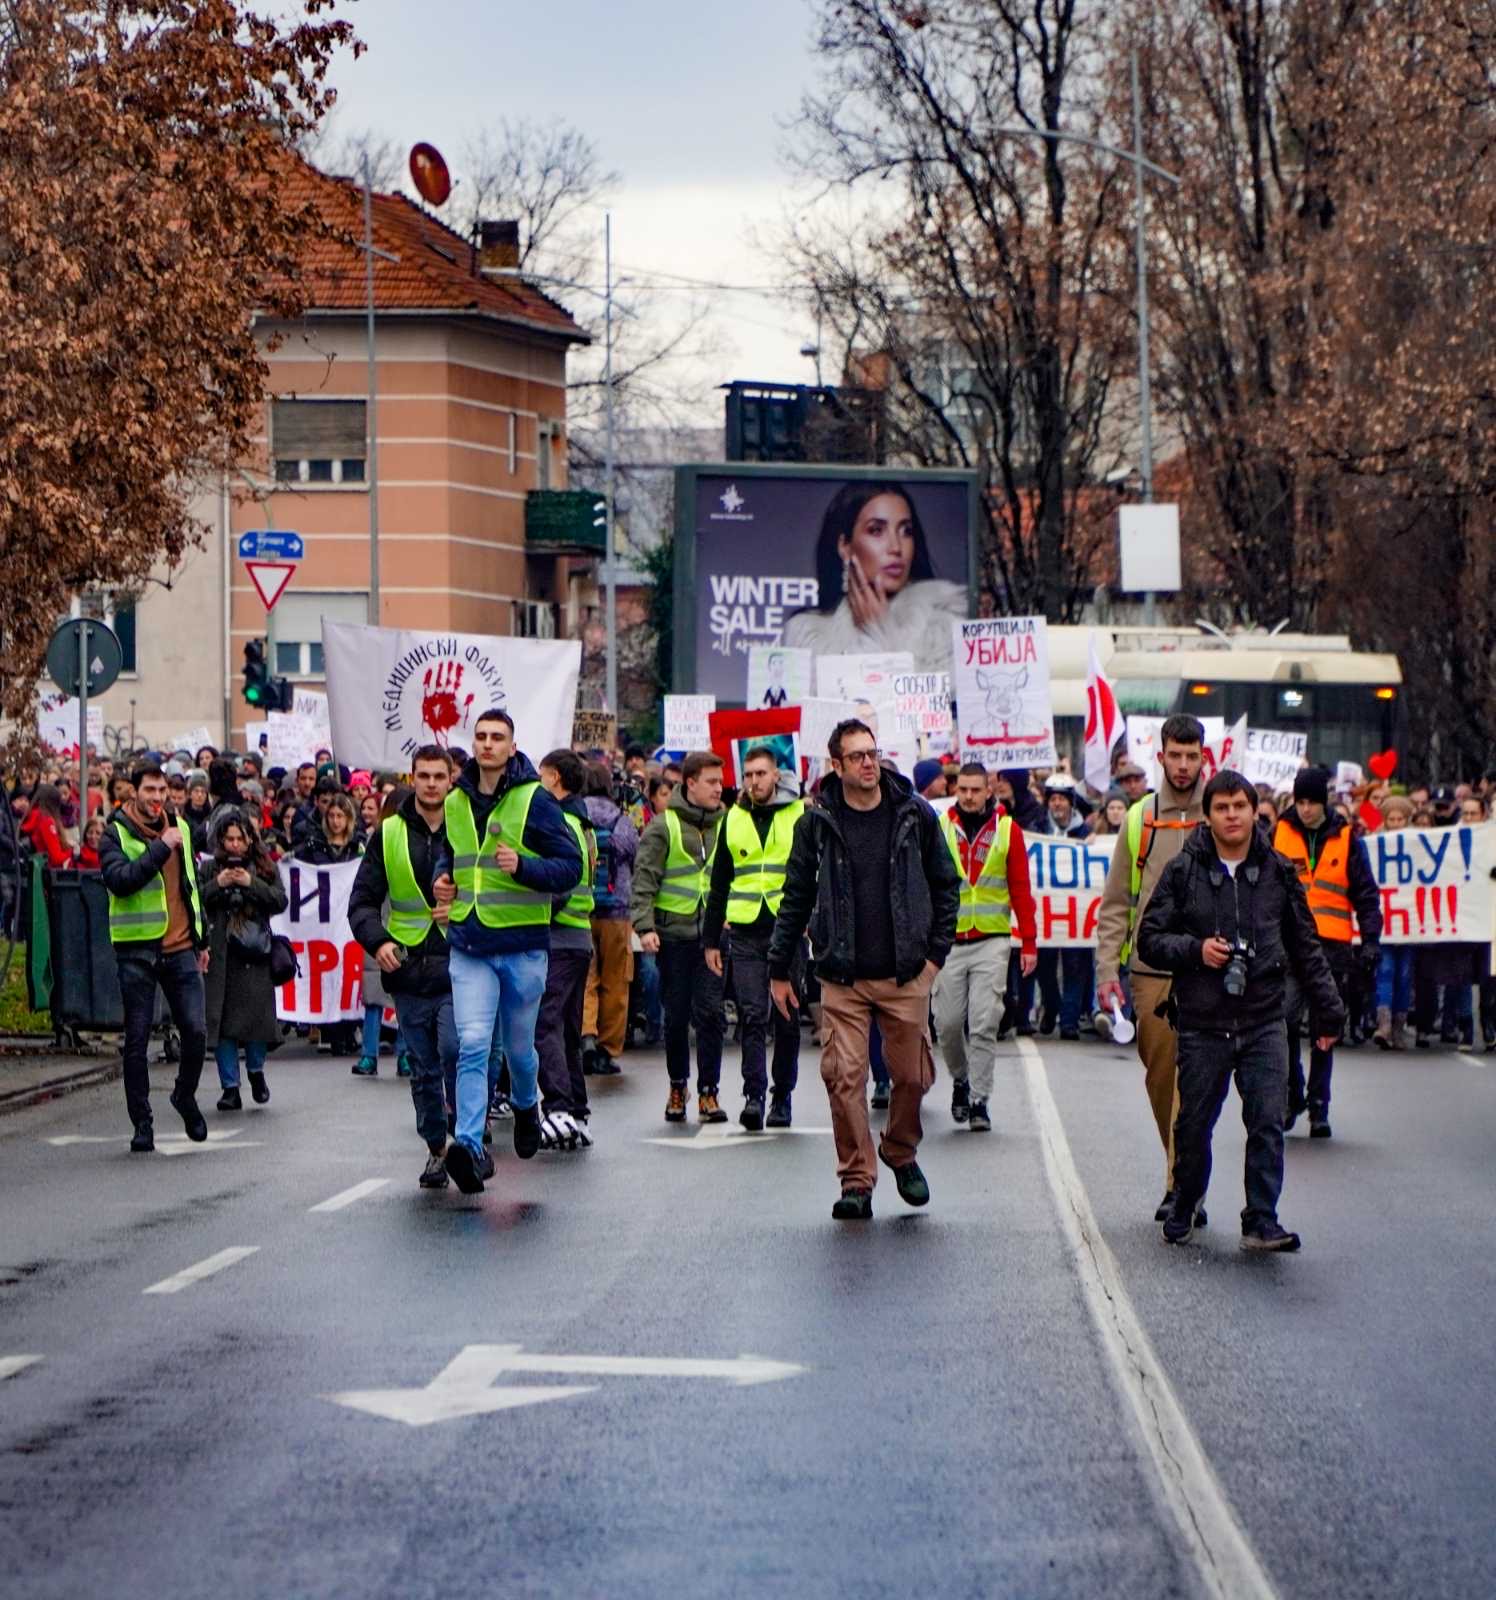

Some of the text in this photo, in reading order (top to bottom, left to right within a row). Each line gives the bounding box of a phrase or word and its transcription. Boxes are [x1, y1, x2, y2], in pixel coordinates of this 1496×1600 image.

[710, 575, 819, 606] WINTER
[710, 607, 784, 634] SALE
[962, 619, 1036, 638] КОРУПЦИЈА
[964, 634, 1038, 666] УБИЈА
[382, 638, 457, 732] МЕДИЦИНСКИ
